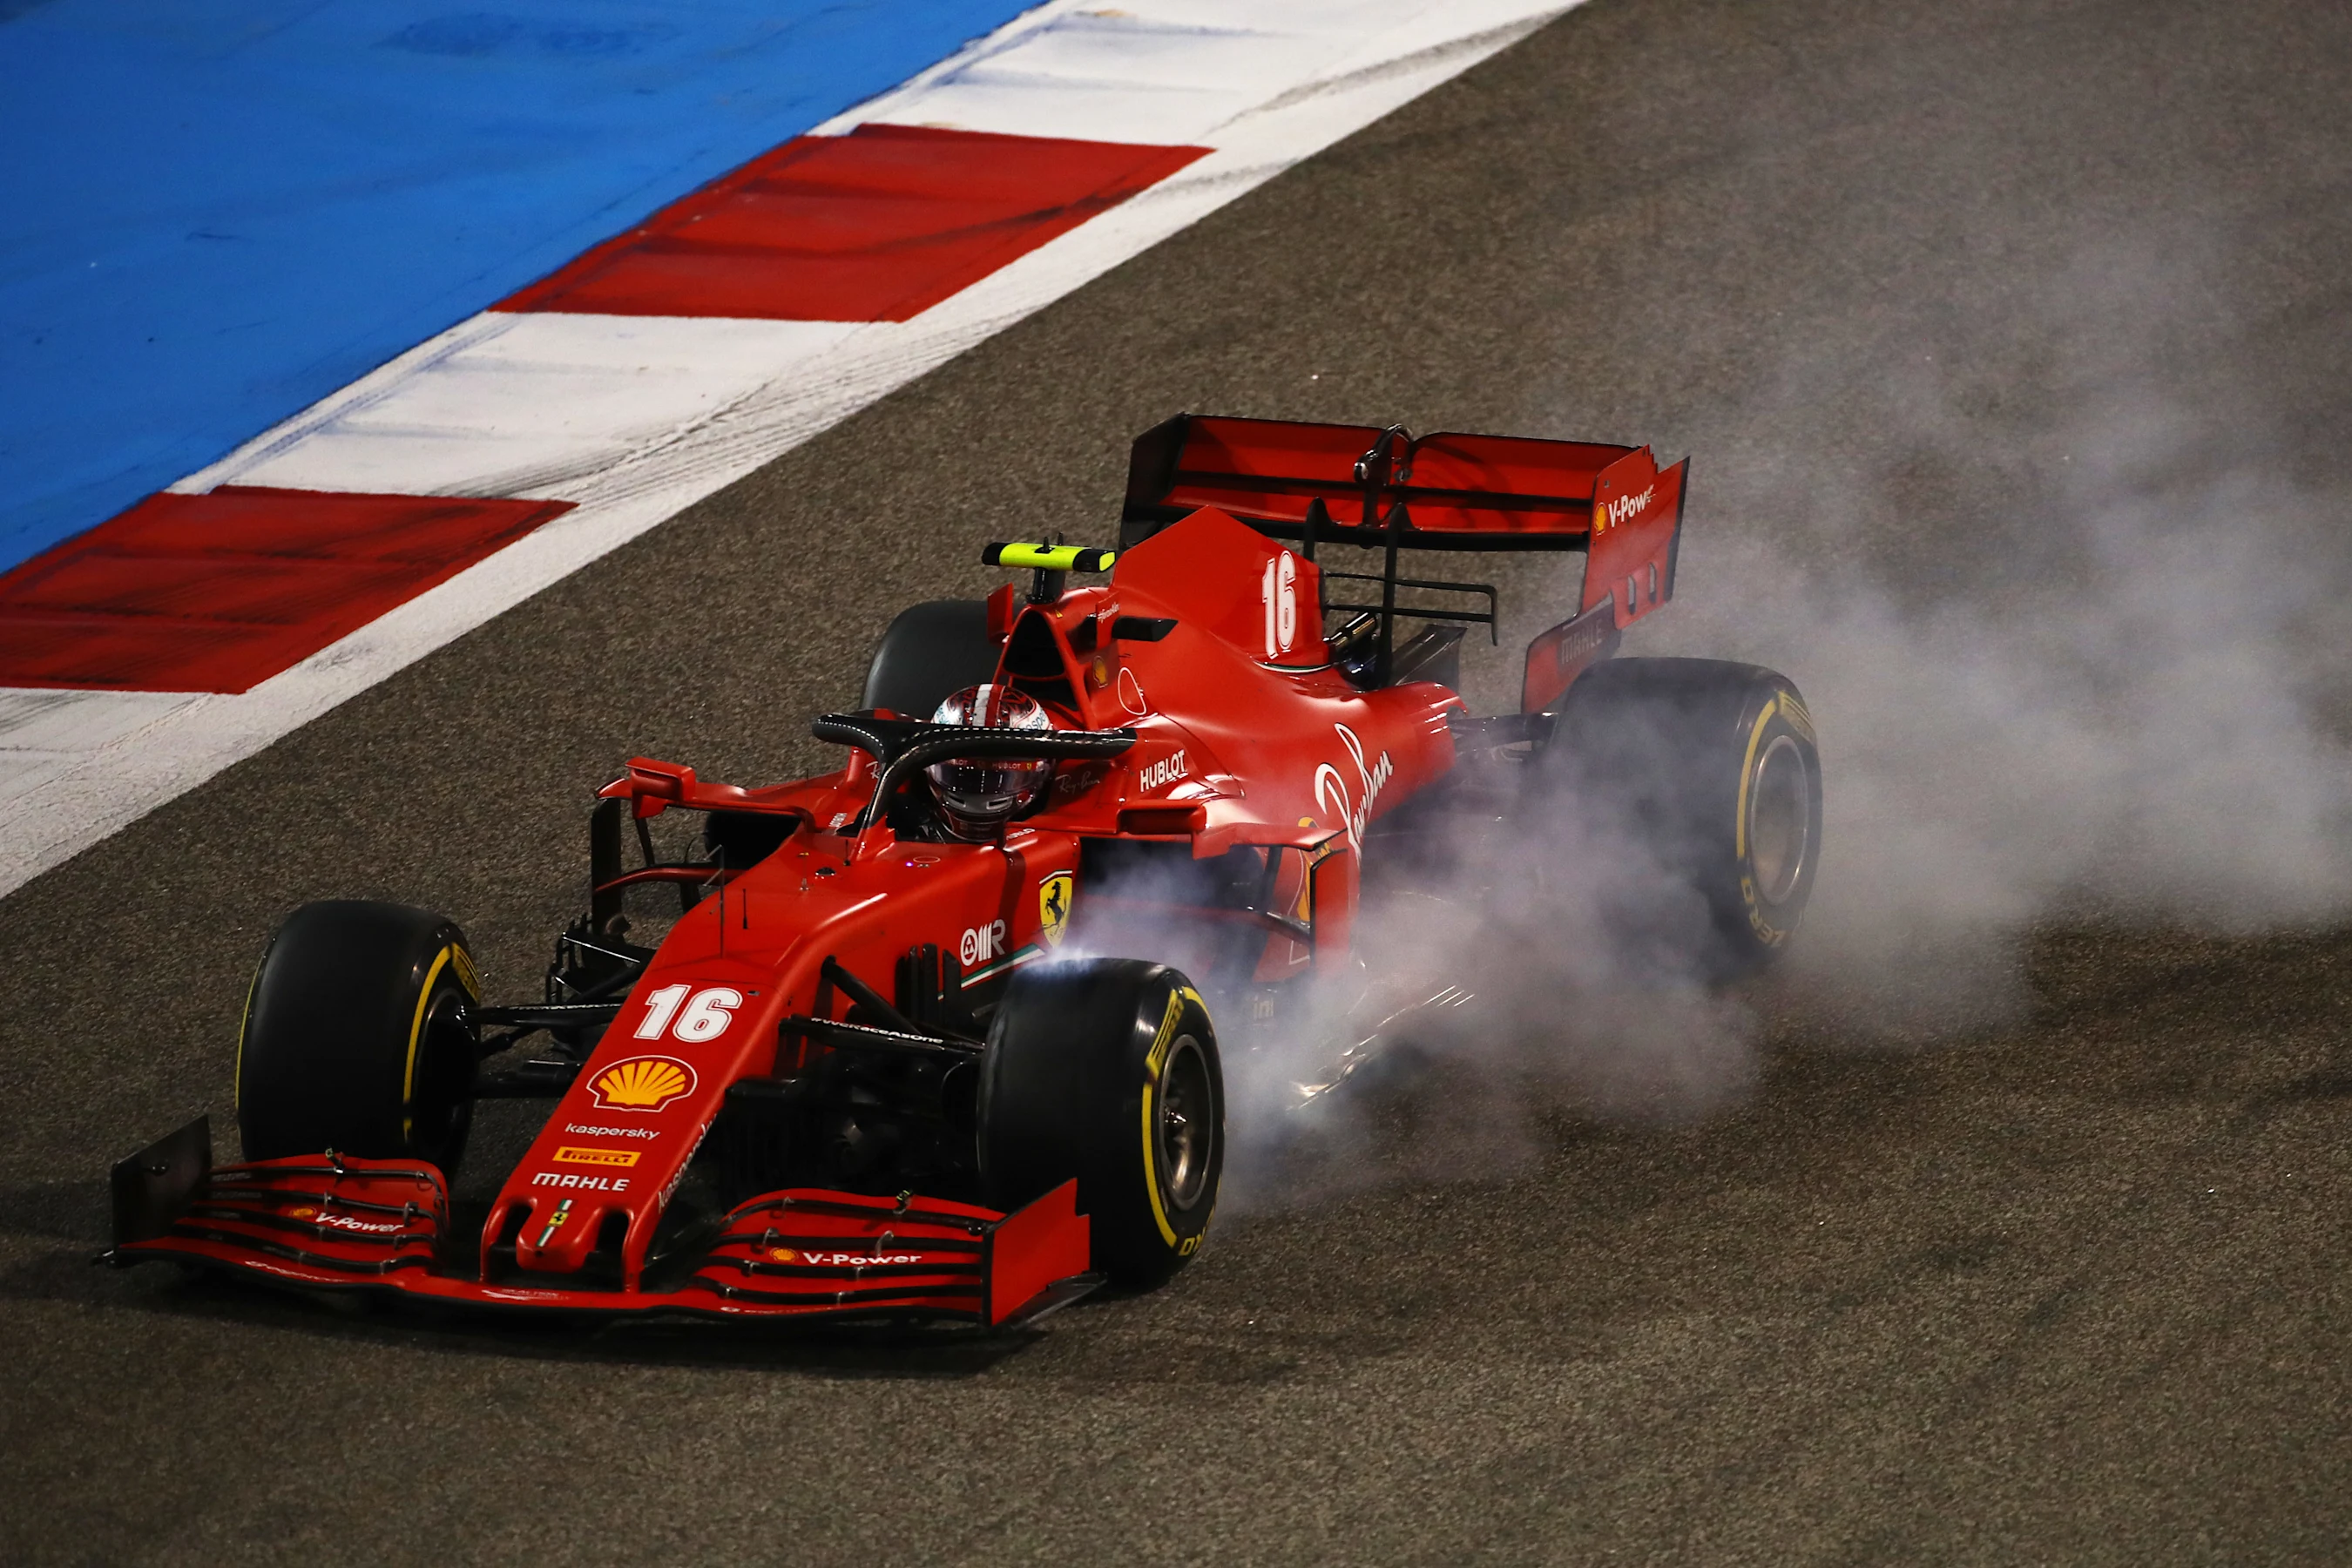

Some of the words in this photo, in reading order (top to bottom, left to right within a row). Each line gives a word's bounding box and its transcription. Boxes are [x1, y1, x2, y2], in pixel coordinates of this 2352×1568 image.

[1261, 551, 1296, 659] 16
[1139, 749, 1187, 792] HUBLOT
[633, 983, 743, 1043] 16
[811, 1017, 944, 1044] #WeRaceAsOne
[564, 1122, 660, 1141] kaspersky
[558, 1149, 632, 1165] PIRELLI
[532, 1172, 630, 1193] MAHLE
[314, 1212, 404, 1233] V-Power
[802, 1252, 923, 1266] V-Power
